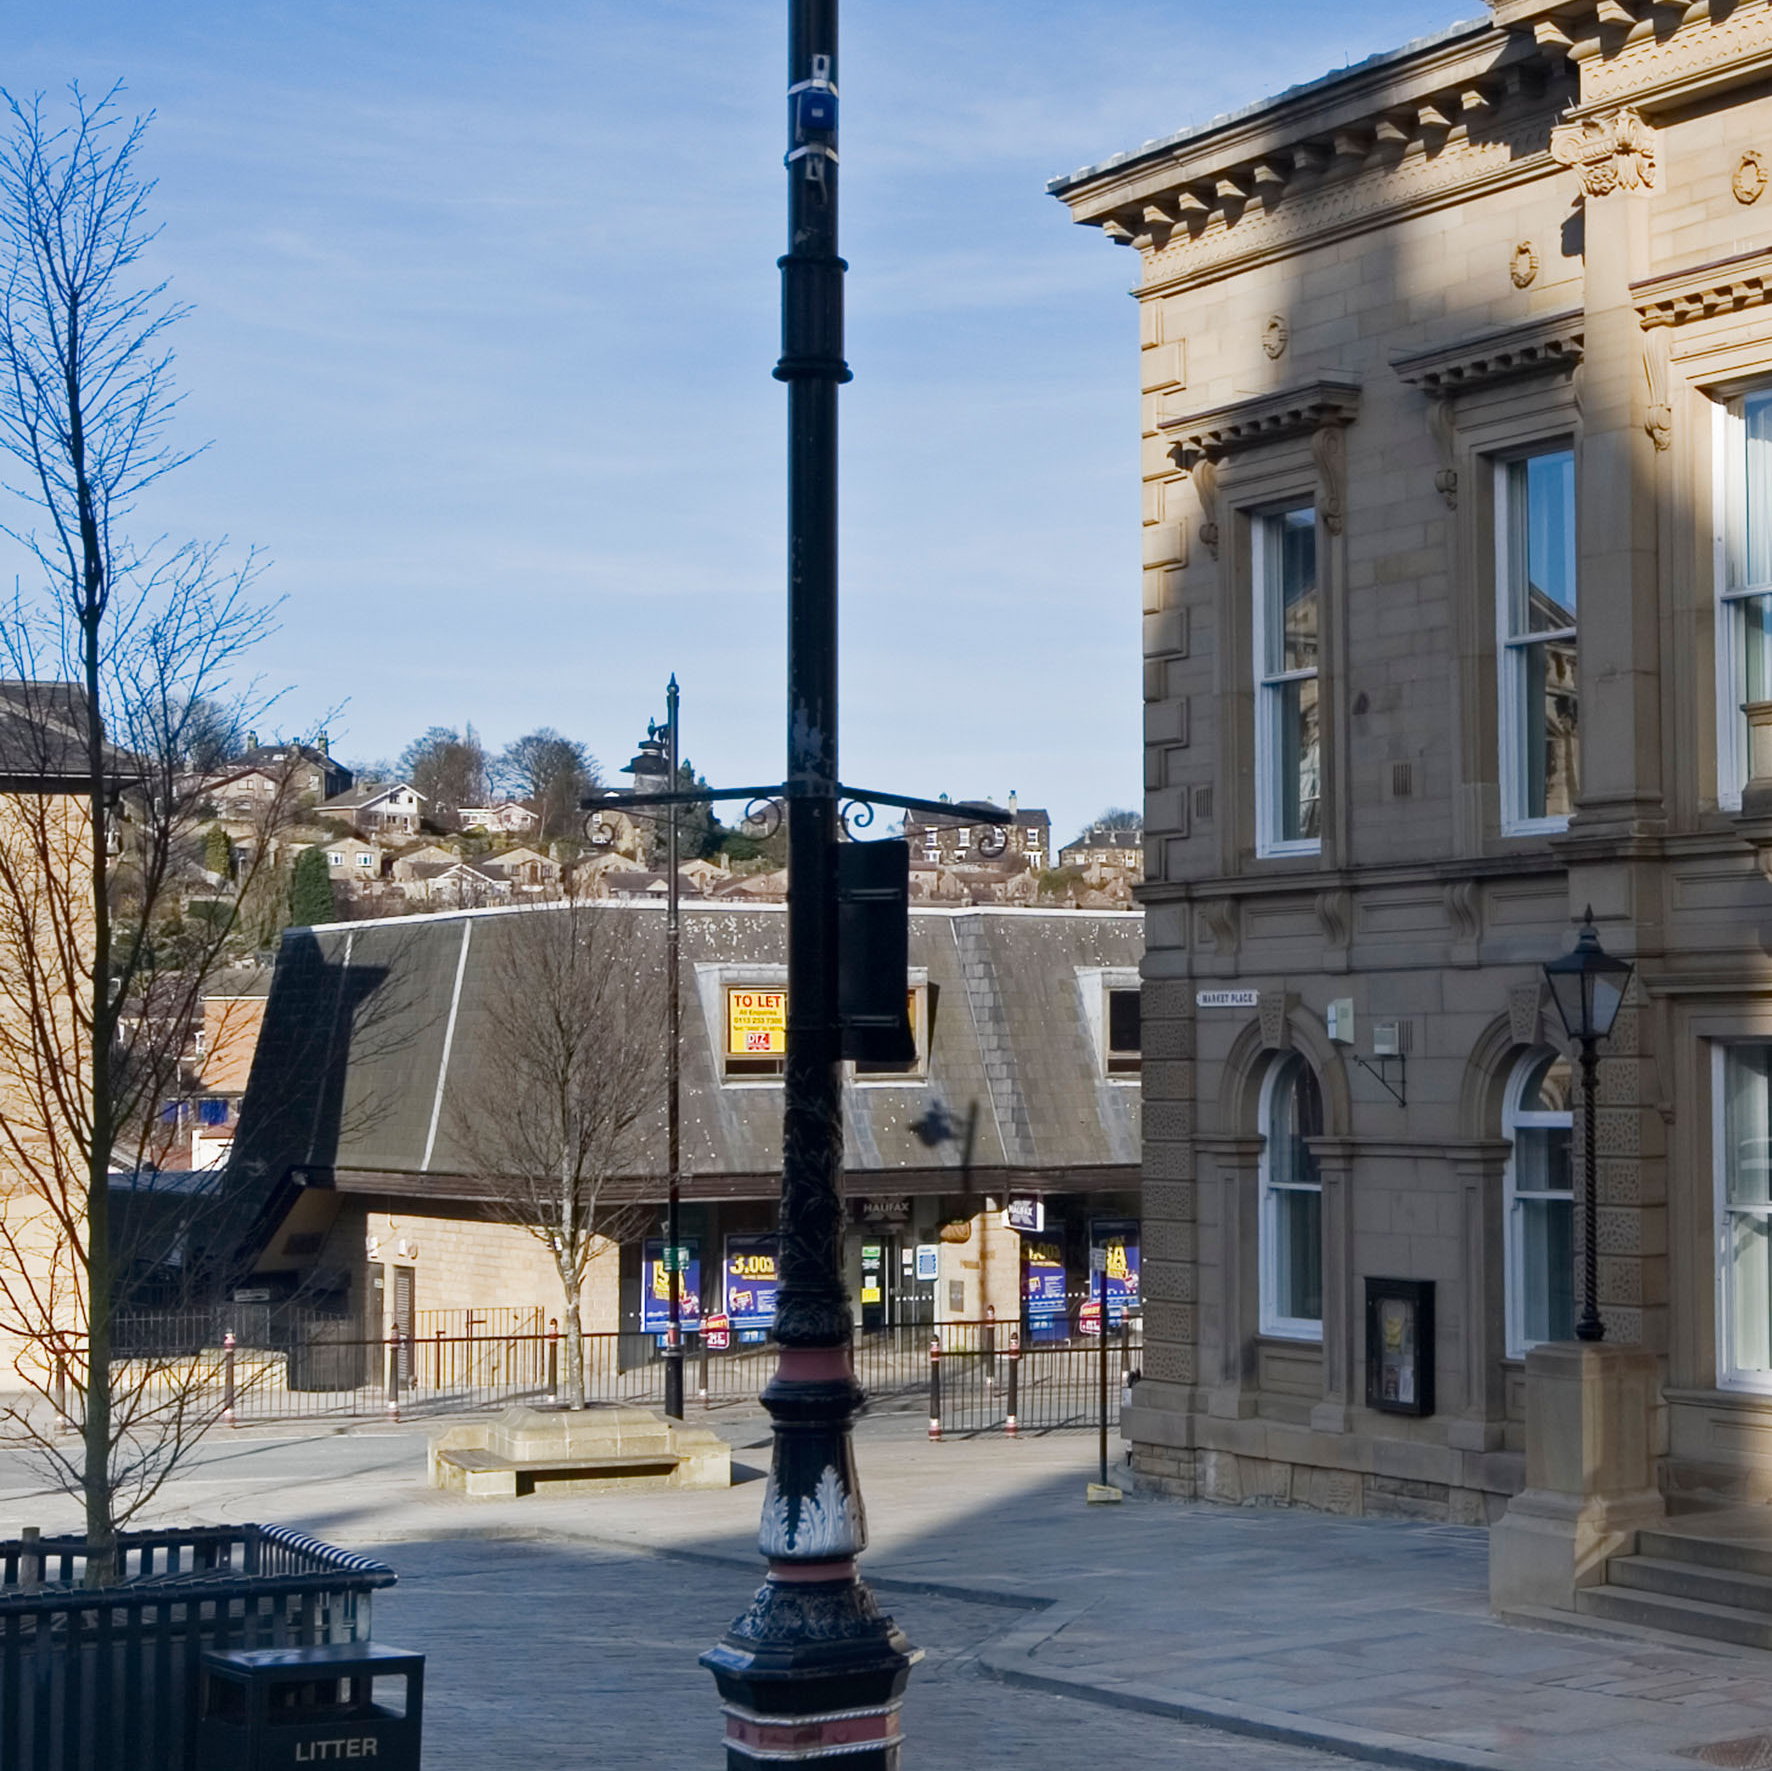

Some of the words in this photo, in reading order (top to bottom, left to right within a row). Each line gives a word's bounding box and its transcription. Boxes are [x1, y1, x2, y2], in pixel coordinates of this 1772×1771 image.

[734, 995, 753, 1008] TO
[758, 995, 781, 1008] LET
[1202, 993, 1229, 1004] MARKET
[1231, 993, 1253, 1003] PLACE
[748, 1034, 766, 1044] DTZ
[863, 1202, 910, 1213] HALIFAX
[1008, 1203, 1033, 1217] HALIFAX
[295, 1737, 378, 1761] LITTER
